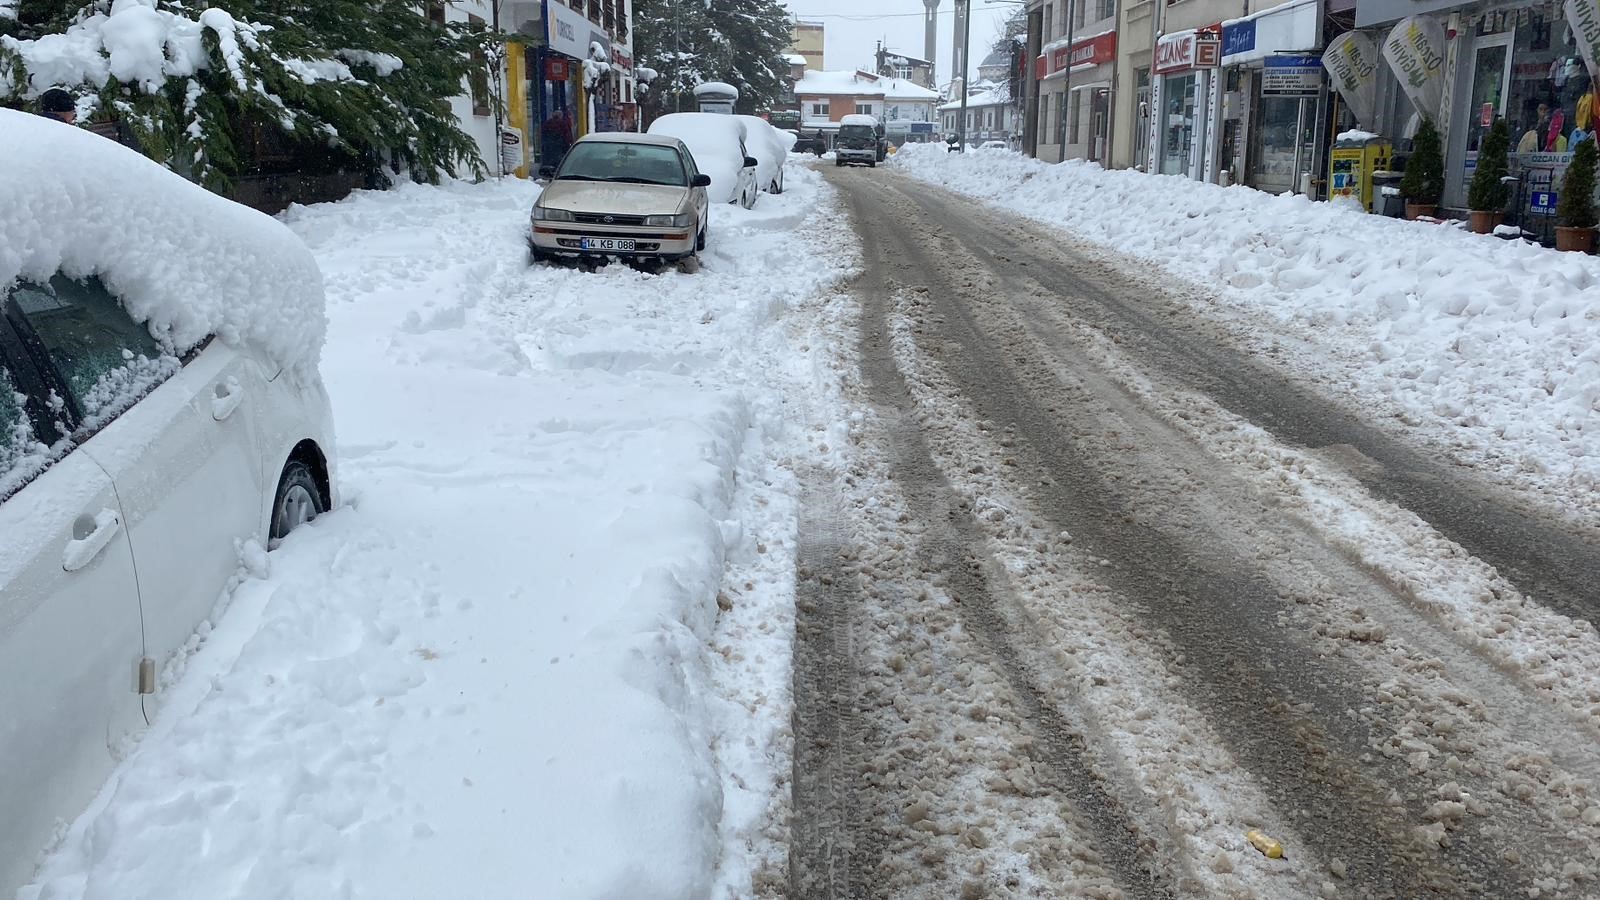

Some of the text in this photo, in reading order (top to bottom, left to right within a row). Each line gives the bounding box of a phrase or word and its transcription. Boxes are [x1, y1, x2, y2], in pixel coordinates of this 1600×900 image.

[557, 18, 575, 42] TURKCELL
[1200, 46, 1214, 62] E
[1149, 85, 1159, 170] ECZANE
[1205, 75, 1216, 173] ECZANE
[587, 239, 634, 250] 14 KB 088
